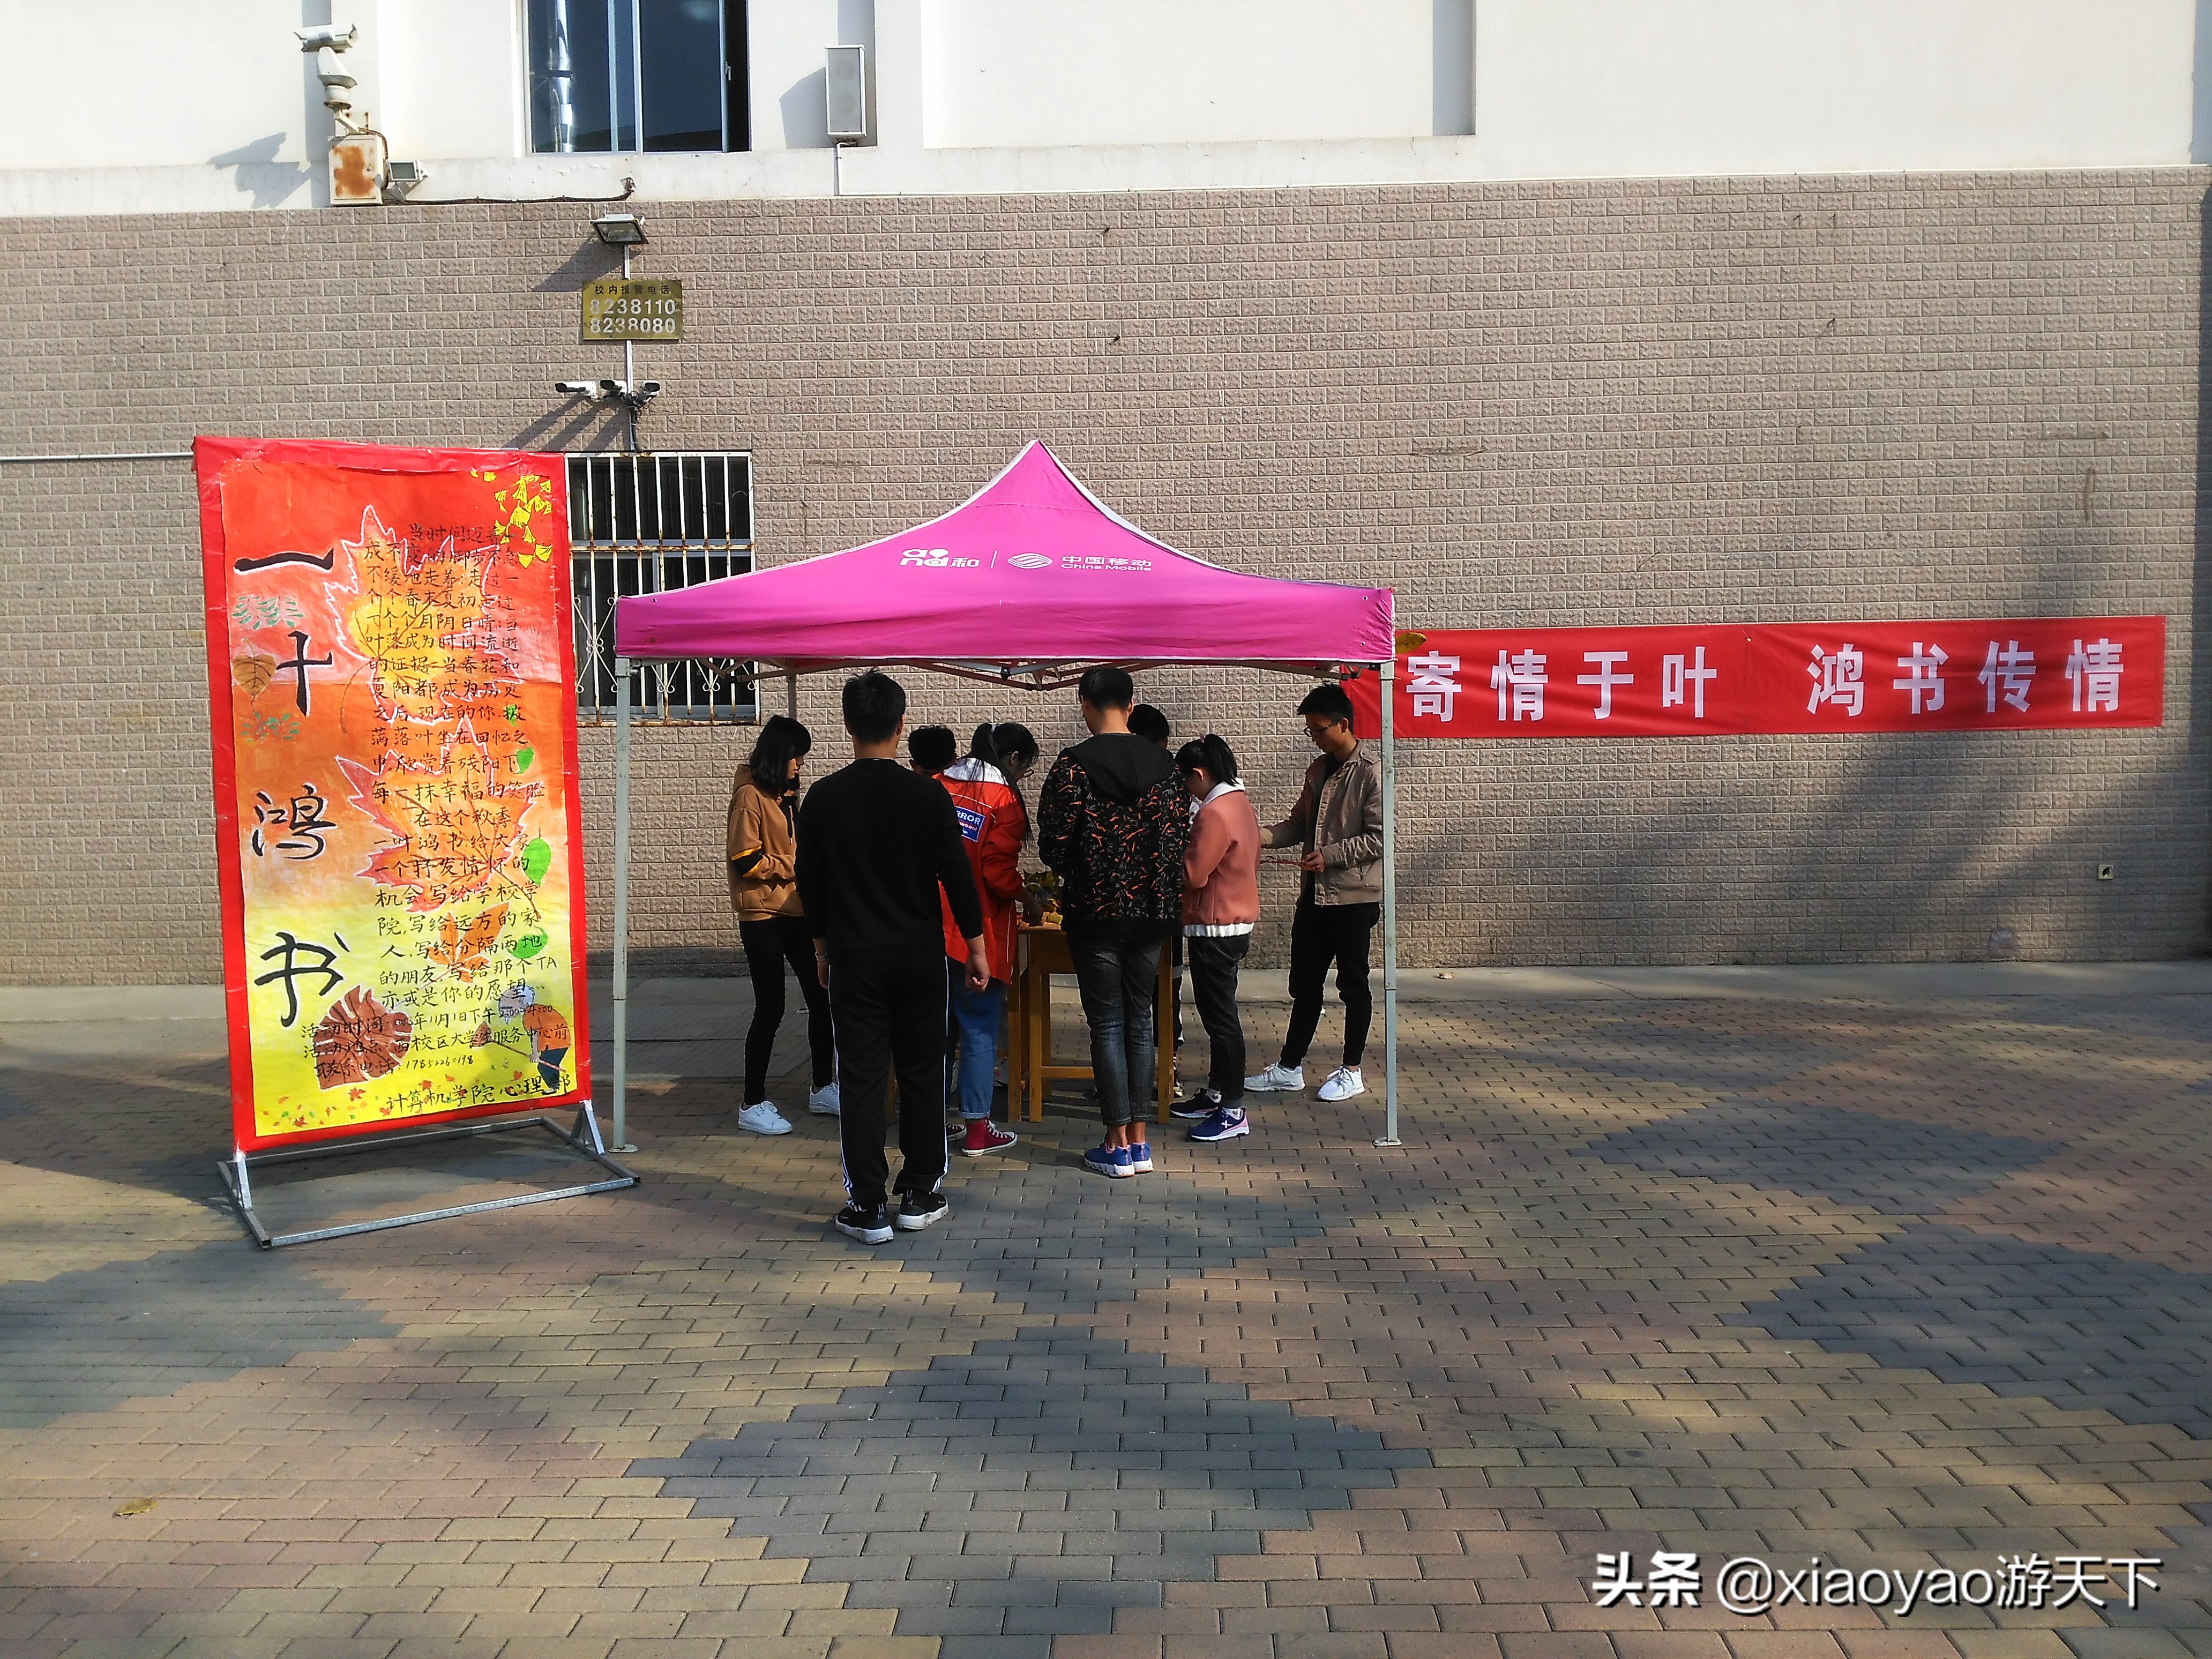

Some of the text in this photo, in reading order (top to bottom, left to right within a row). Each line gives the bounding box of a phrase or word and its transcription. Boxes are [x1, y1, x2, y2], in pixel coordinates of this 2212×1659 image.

[590, 298, 676, 315] 8238110
[590, 317, 676, 333] 8238080
[1062, 555, 1152, 567] 中国移动
[1406, 638, 2124, 722] 寄情于叶 鸿书传情
